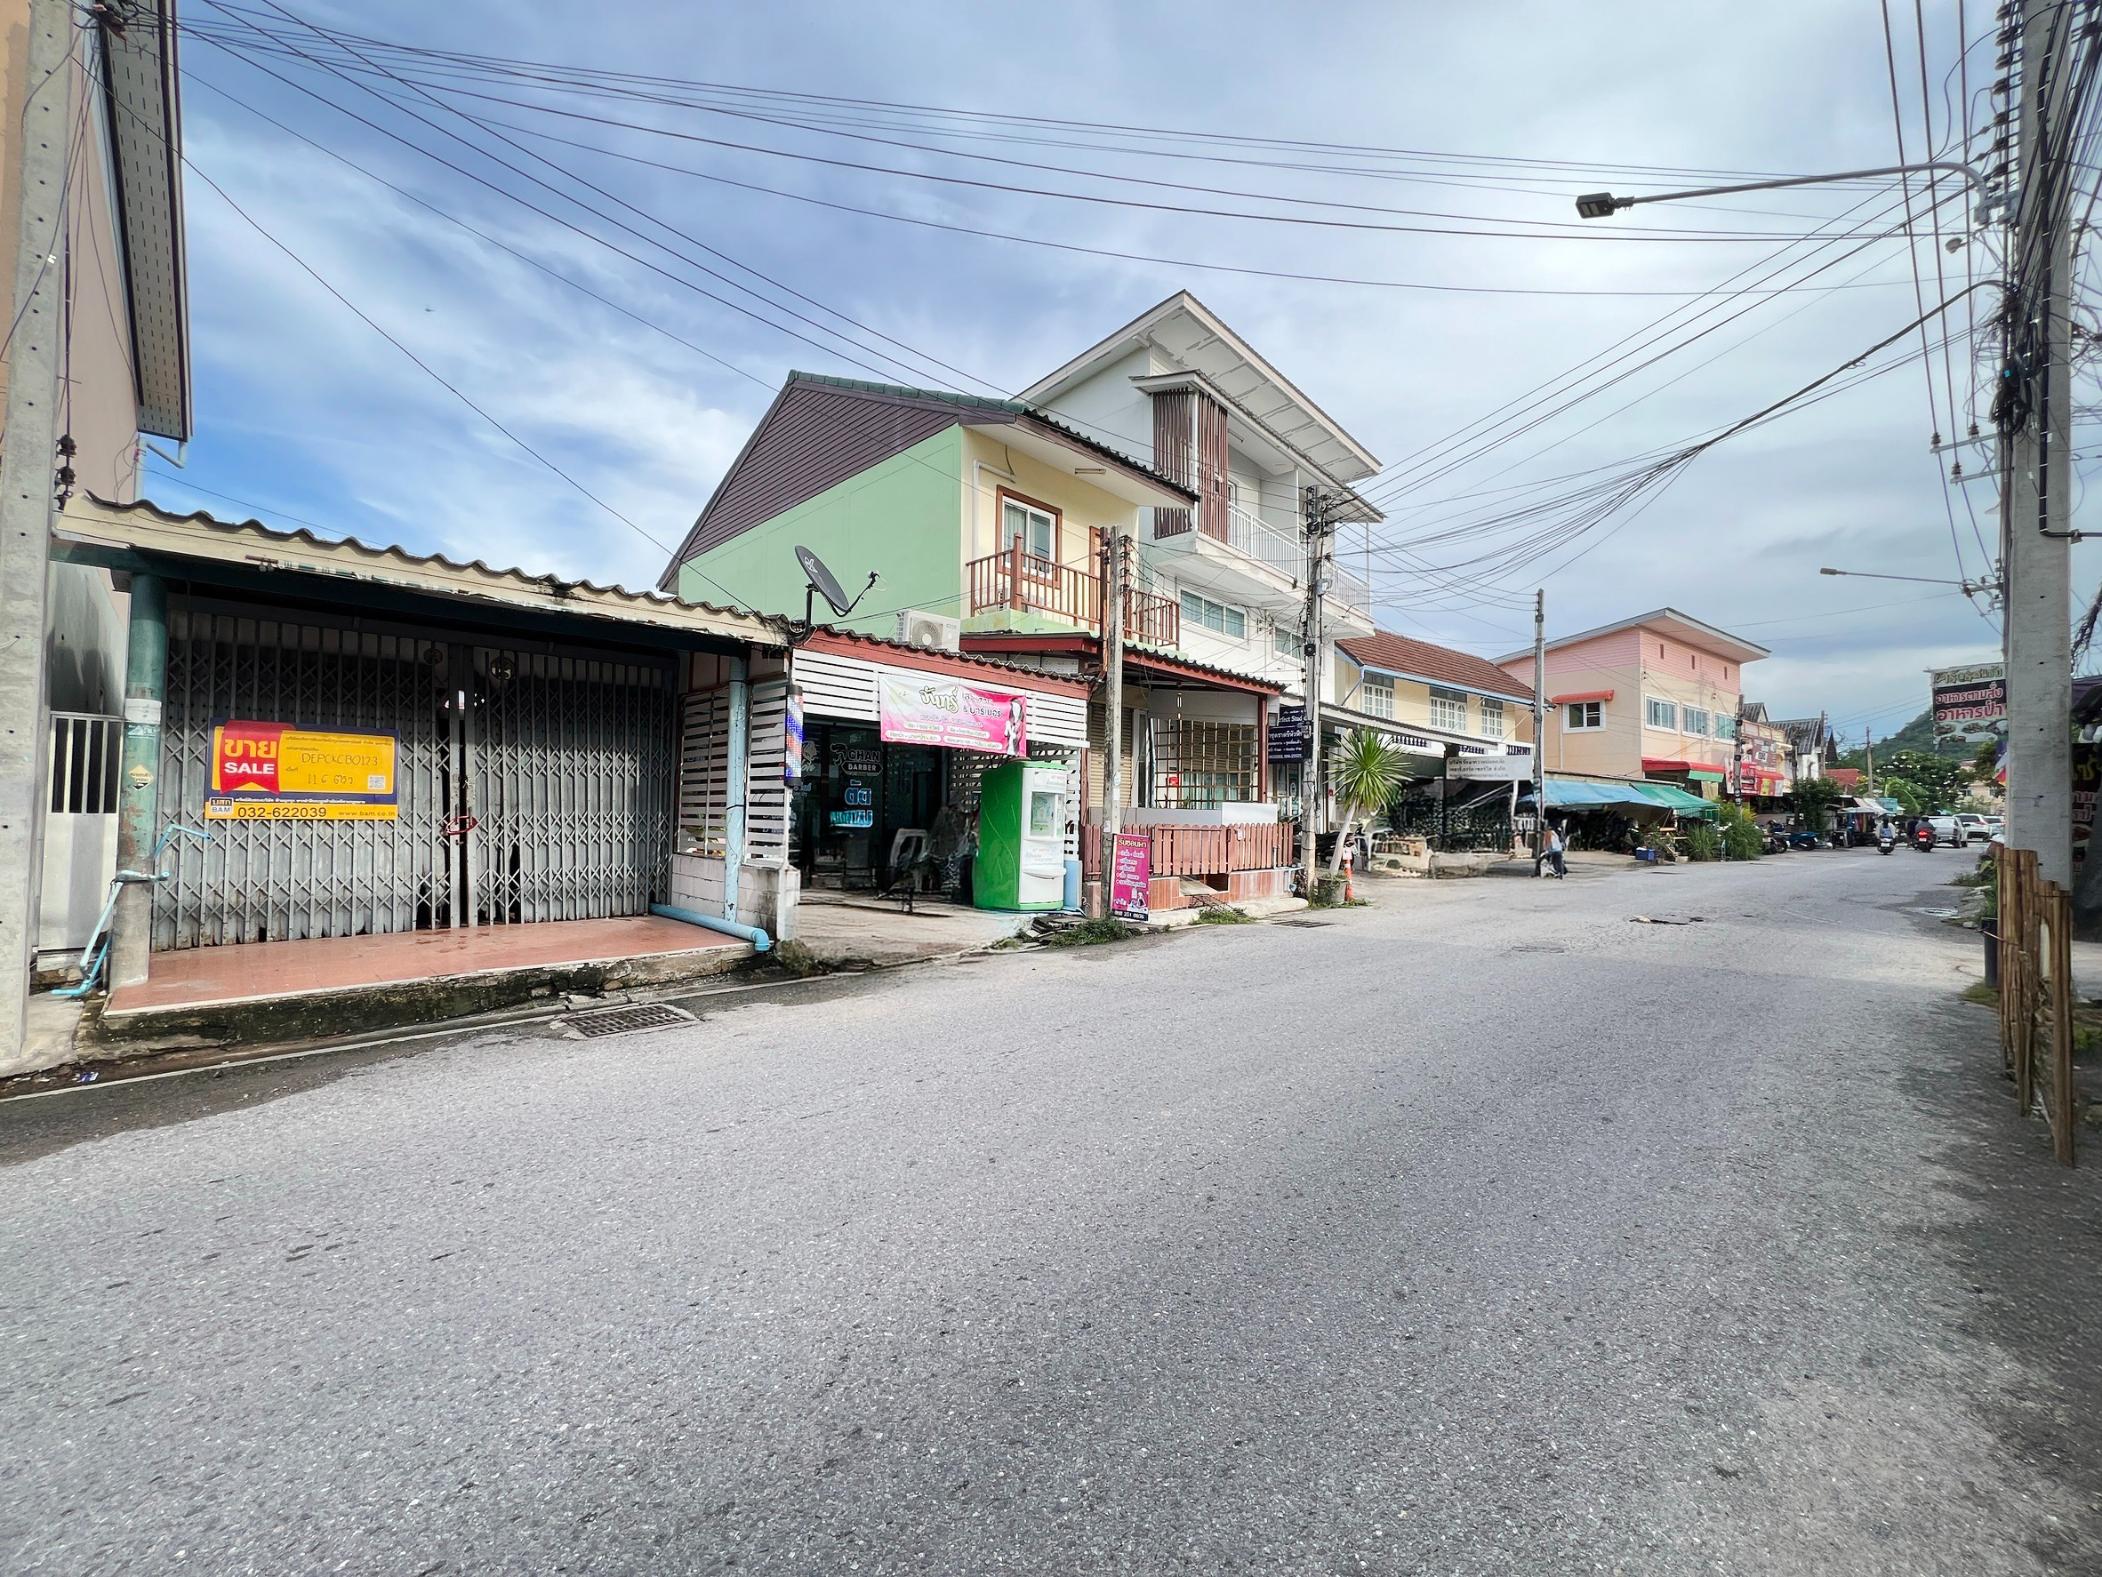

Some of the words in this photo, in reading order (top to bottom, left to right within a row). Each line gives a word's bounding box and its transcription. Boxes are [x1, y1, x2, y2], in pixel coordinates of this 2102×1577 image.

[1936, 682, 2004, 704] อาหารตามสั่ง
[1937, 700, 2004, 721] อาหารป่า
[225, 739, 277, 758] ขาย
[847, 750, 881, 762] CHAN
[224, 762, 275, 775] SALE
[847, 763, 877, 771] BARBER
[238, 807, 327, 818] 032-622039
